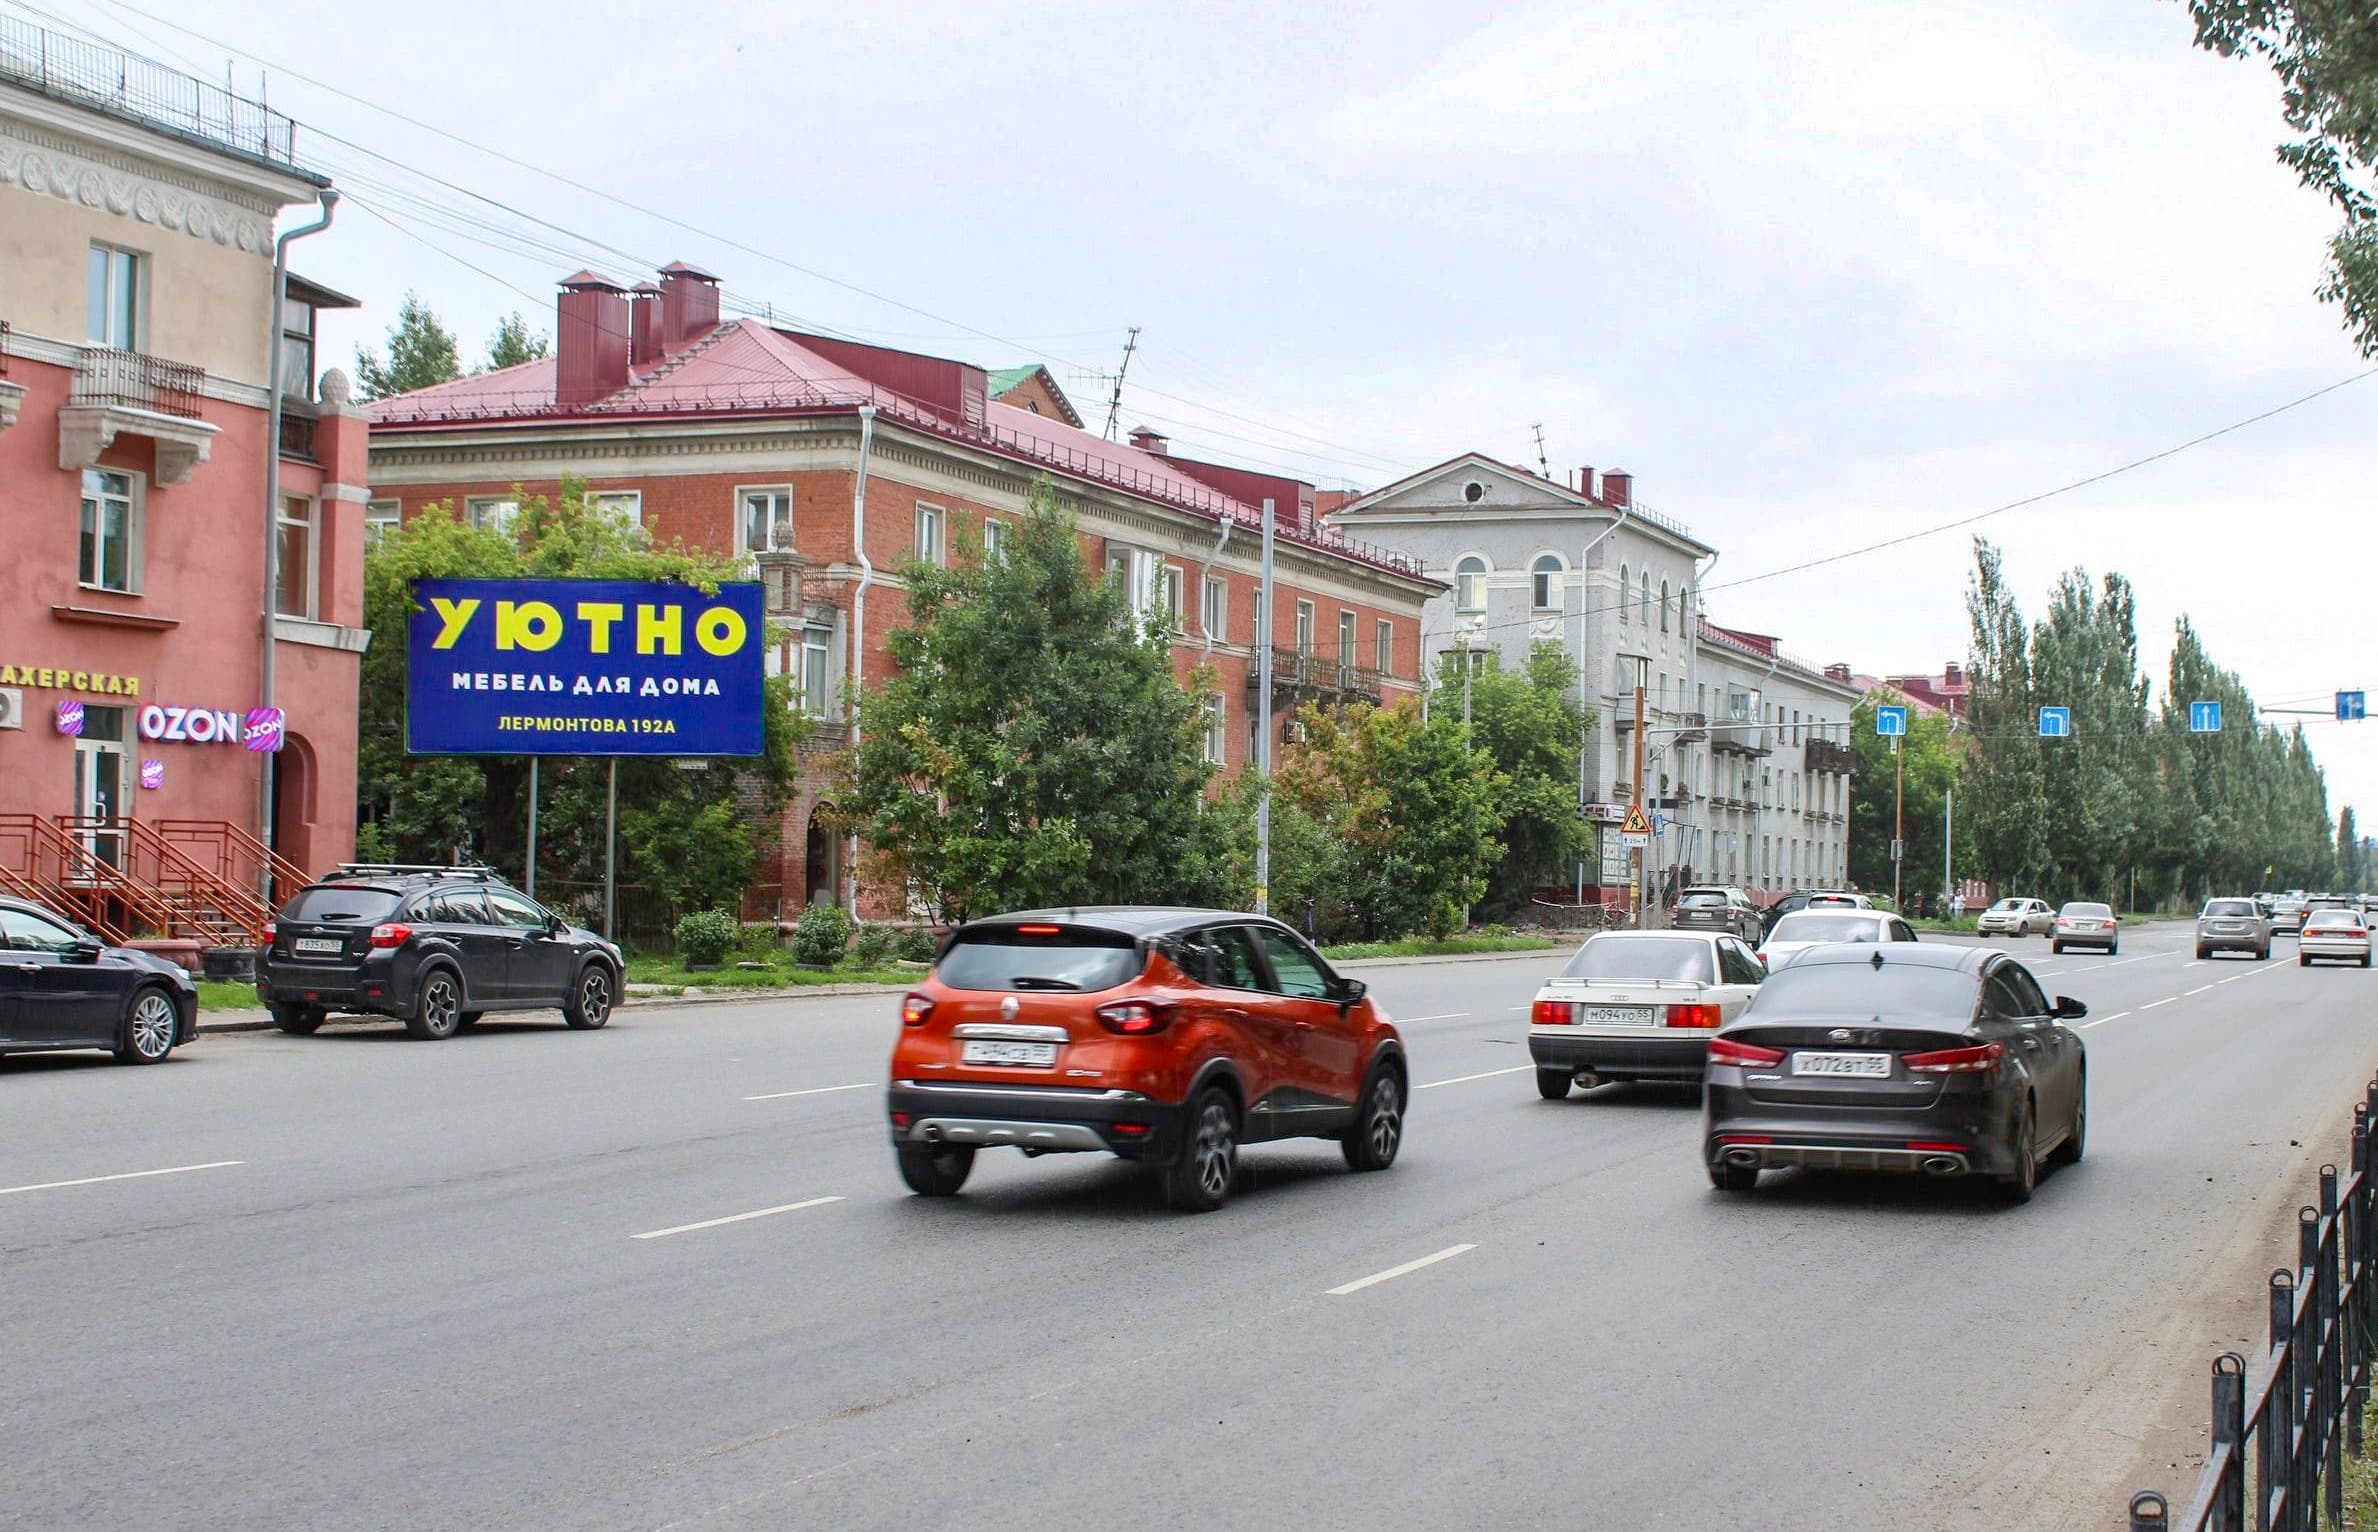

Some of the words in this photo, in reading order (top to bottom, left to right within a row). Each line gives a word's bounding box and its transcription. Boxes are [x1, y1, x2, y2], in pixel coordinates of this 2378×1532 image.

[431, 598, 747, 656] УЮТНО
[453, 672, 564, 693] МЕБЕЛЬ
[573, 675, 631, 696] ДЛЯ
[640, 677, 721, 697] ДОМА
[141, 705, 237, 743] OZON
[245, 719, 282, 740] OZON
[498, 716, 627, 733] ЛЕРМОНТОВА
[632, 719, 677, 734] 192А
